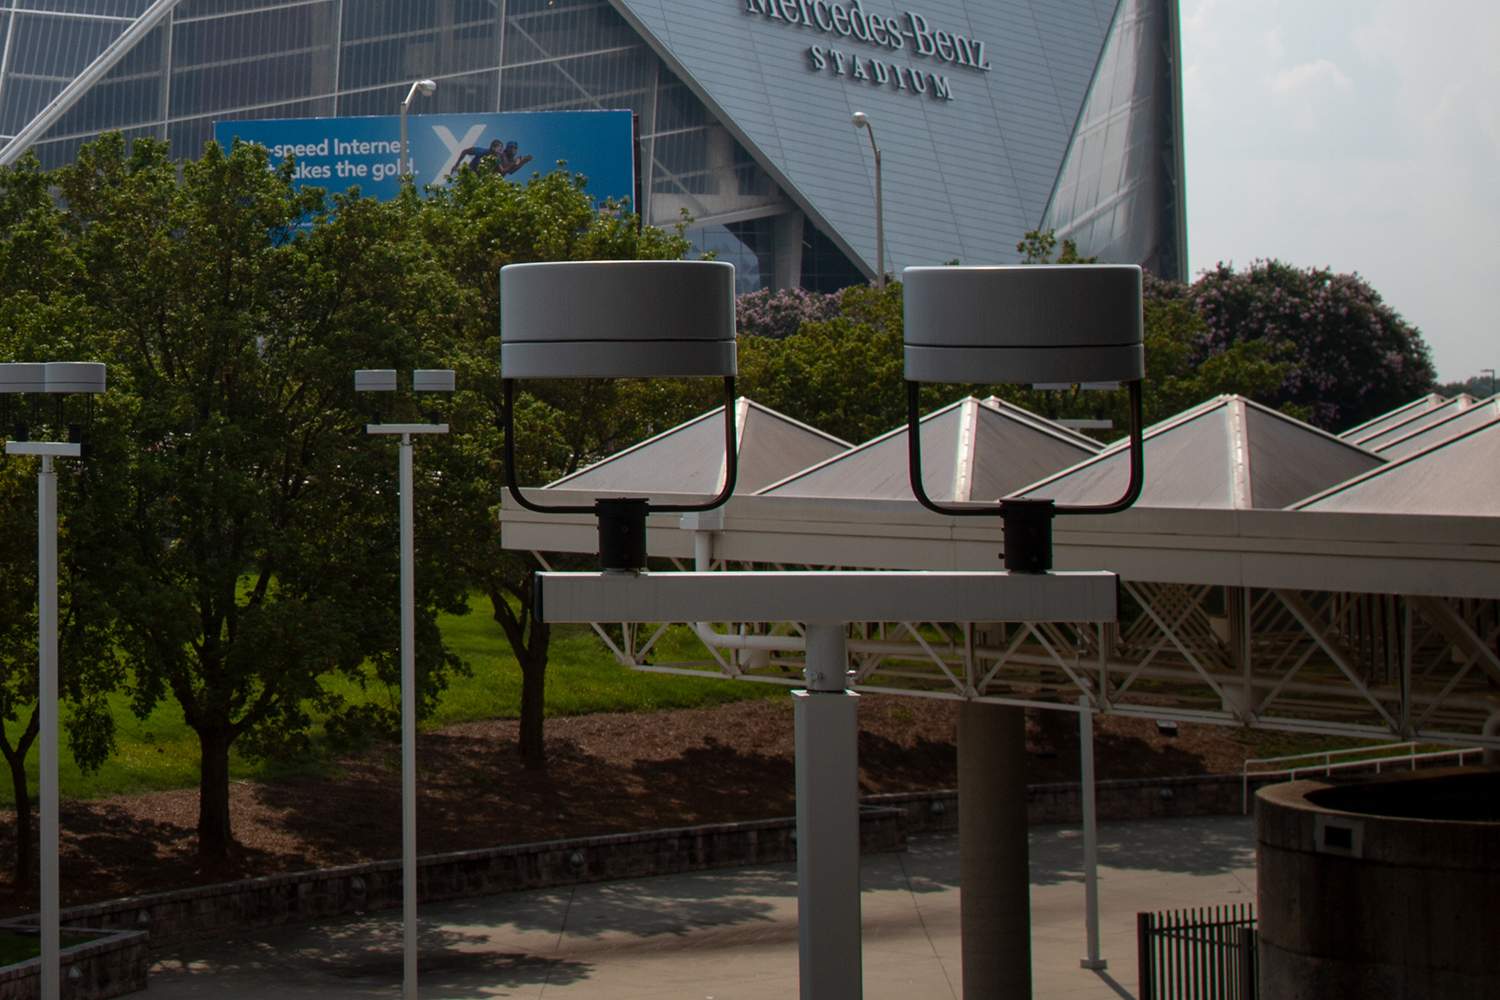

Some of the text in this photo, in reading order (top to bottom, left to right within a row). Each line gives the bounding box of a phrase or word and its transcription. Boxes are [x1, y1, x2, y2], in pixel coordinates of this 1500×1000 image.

[810, 45, 955, 101] STADIUM
[287, 161, 332, 179] akes
[335, 159, 368, 177] the
